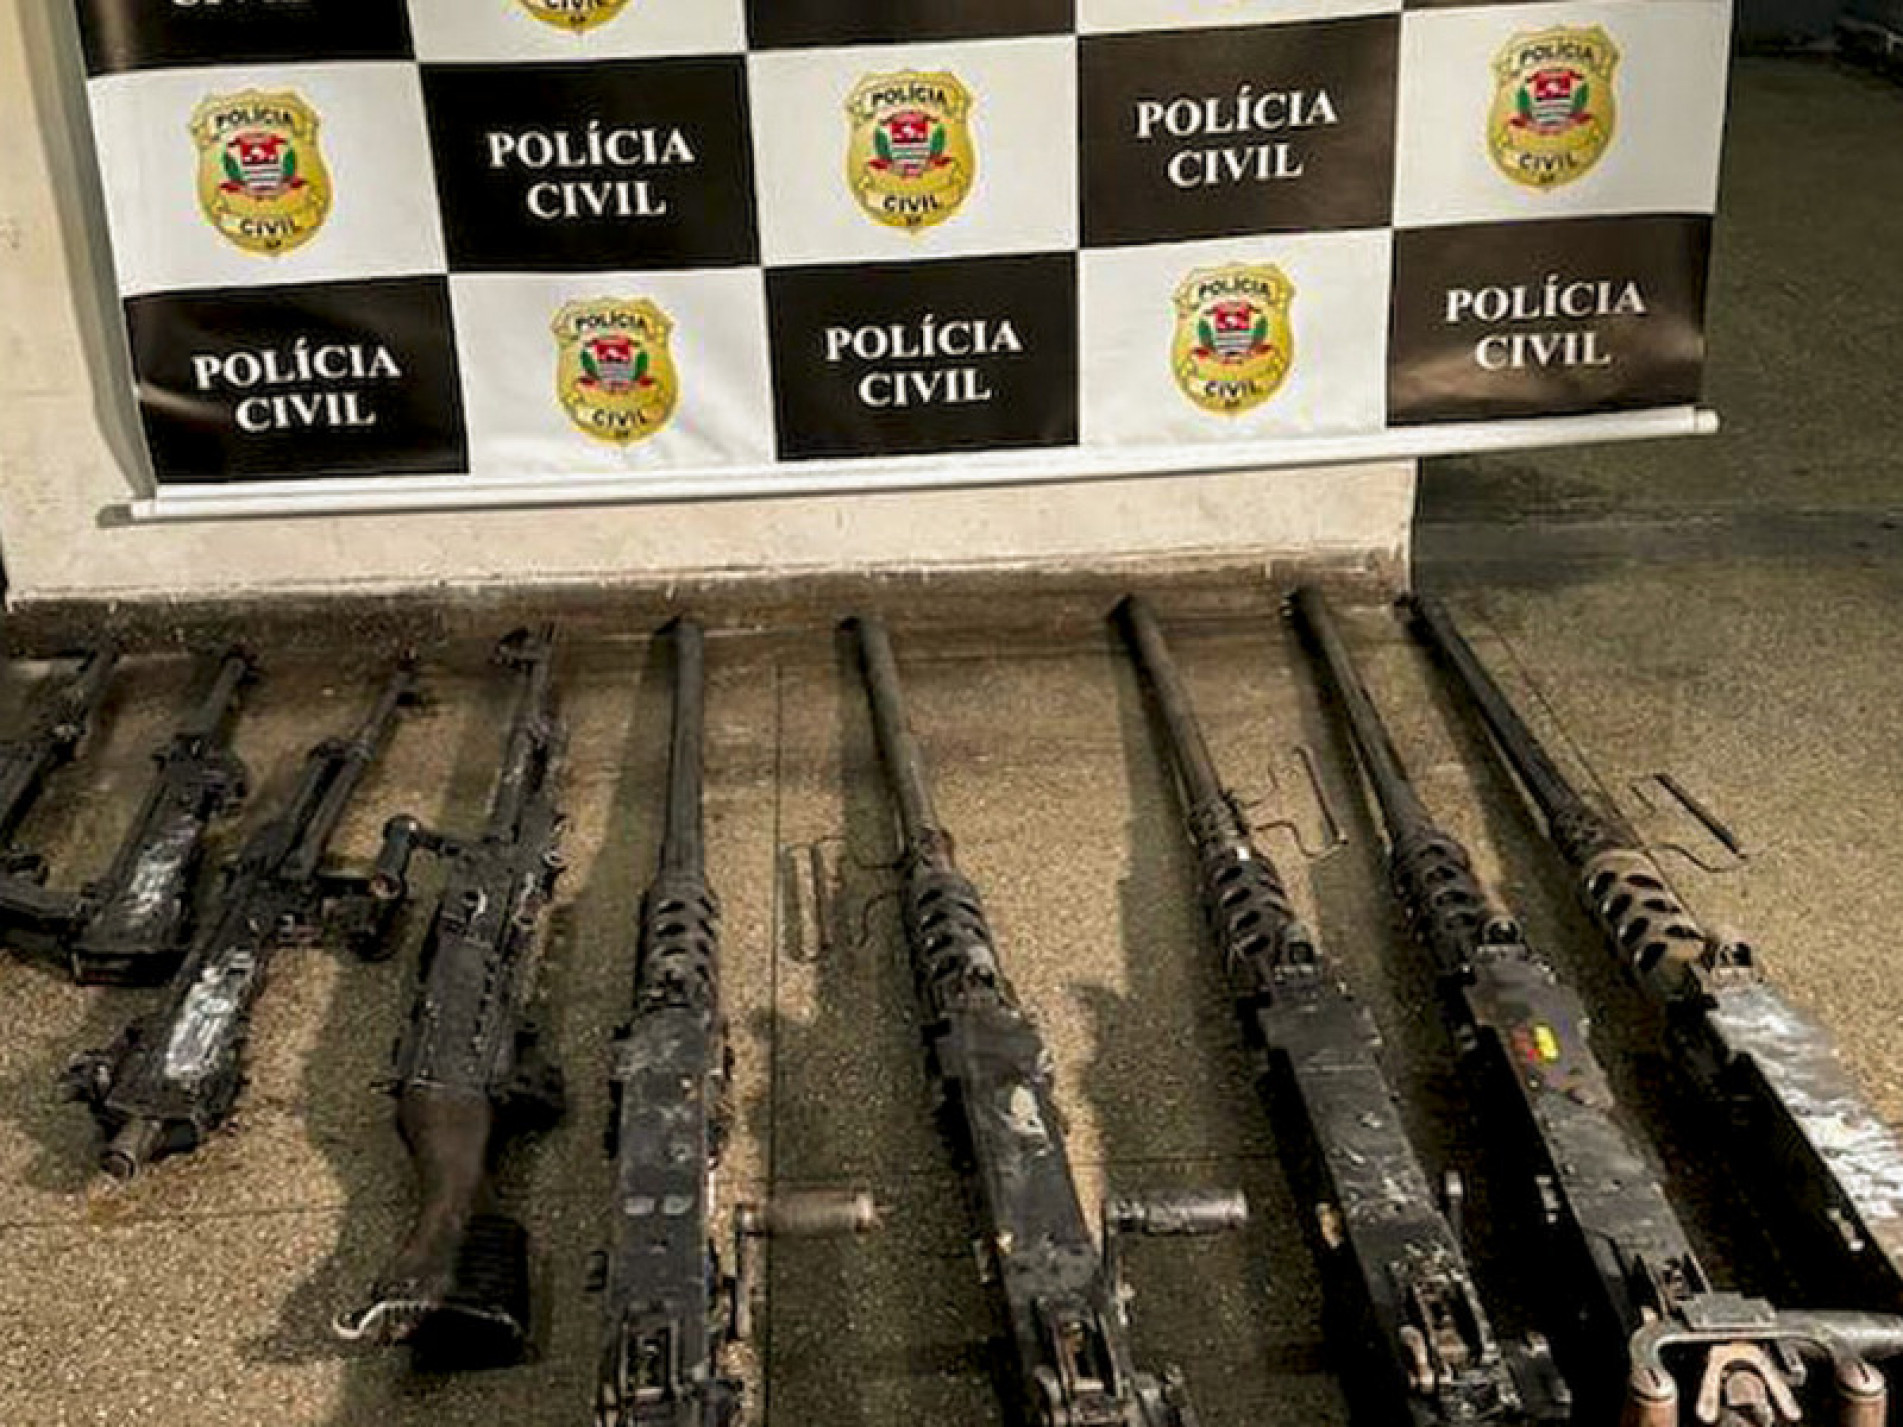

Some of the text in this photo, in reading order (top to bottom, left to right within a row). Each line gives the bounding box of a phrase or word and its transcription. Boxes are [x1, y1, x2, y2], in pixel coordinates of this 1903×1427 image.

[1519, 41, 1594, 65] POLÍCIA
[872, 80, 947, 105] POLÍCIA
[215, 106, 296, 129] POLÍCIA
[1137, 85, 1338, 138] POLÍCIA
[488, 120, 696, 168] POLÍCIA
[1167, 144, 1304, 187] CIVIL
[1519, 152, 1577, 170] CIVIL
[527, 182, 667, 218] CIVIL
[883, 194, 940, 213] CIVIL
[240, 218, 298, 236] CIVIL
[1200, 277, 1271, 298] POLÍCIA
[1445, 275, 1646, 322] POLÍCIA
[575, 311, 647, 331] POLÍCIA
[825, 313, 1023, 362] POLÍCIA
[1474, 332, 1611, 371] CIVIL
[193, 337, 402, 389] POLÍCIA
[858, 368, 991, 406] CIVIL
[1205, 380, 1263, 397] CIVIL
[235, 393, 377, 432] CIVIL
[592, 409, 647, 427] CIVIL
